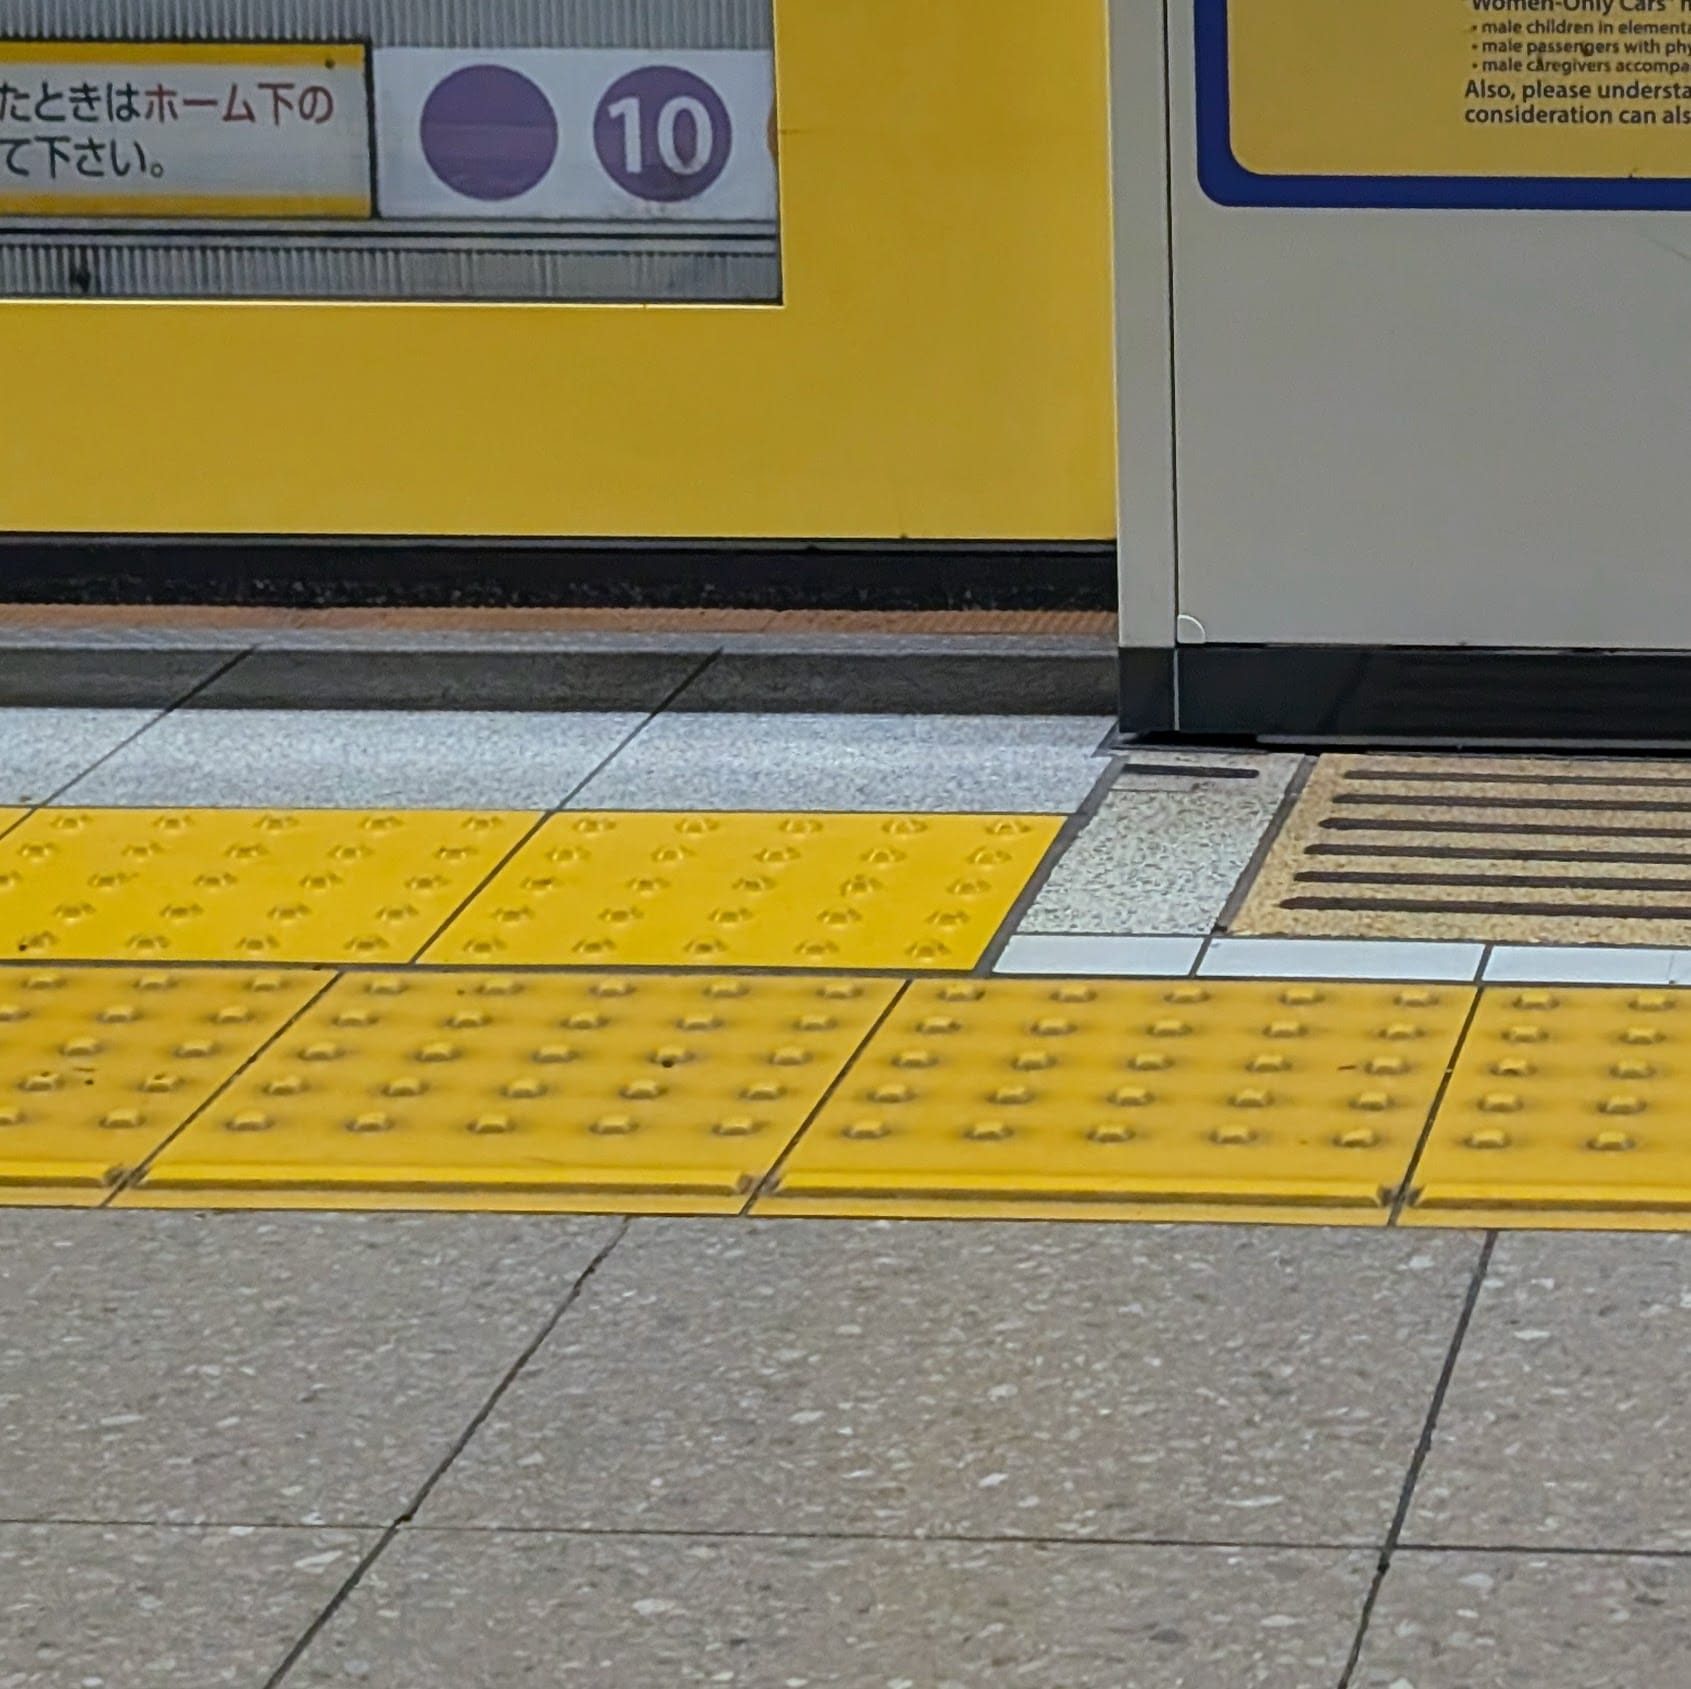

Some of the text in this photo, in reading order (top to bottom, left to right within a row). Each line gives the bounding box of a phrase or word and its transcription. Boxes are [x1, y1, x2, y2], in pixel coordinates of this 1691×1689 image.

[1482, 19, 1522, 34] male
[1526, 19, 1594, 34] children
[1598, 20, 1613, 34] in
[1482, 39, 1522, 53] male
[1526, 42, 1619, 57] passengers
[1624, 38, 1660, 54] with
[1482, 57, 1522, 72] male
[1526, 58, 1611, 76] caregivers
[1464, 79, 1691, 103] Also, please understa
[1464, 103, 1612, 124] consideration
[1618, 109, 1657, 124] can
[608, 96, 713, 175] 10
[0, 136, 164, 178] て下さい。
